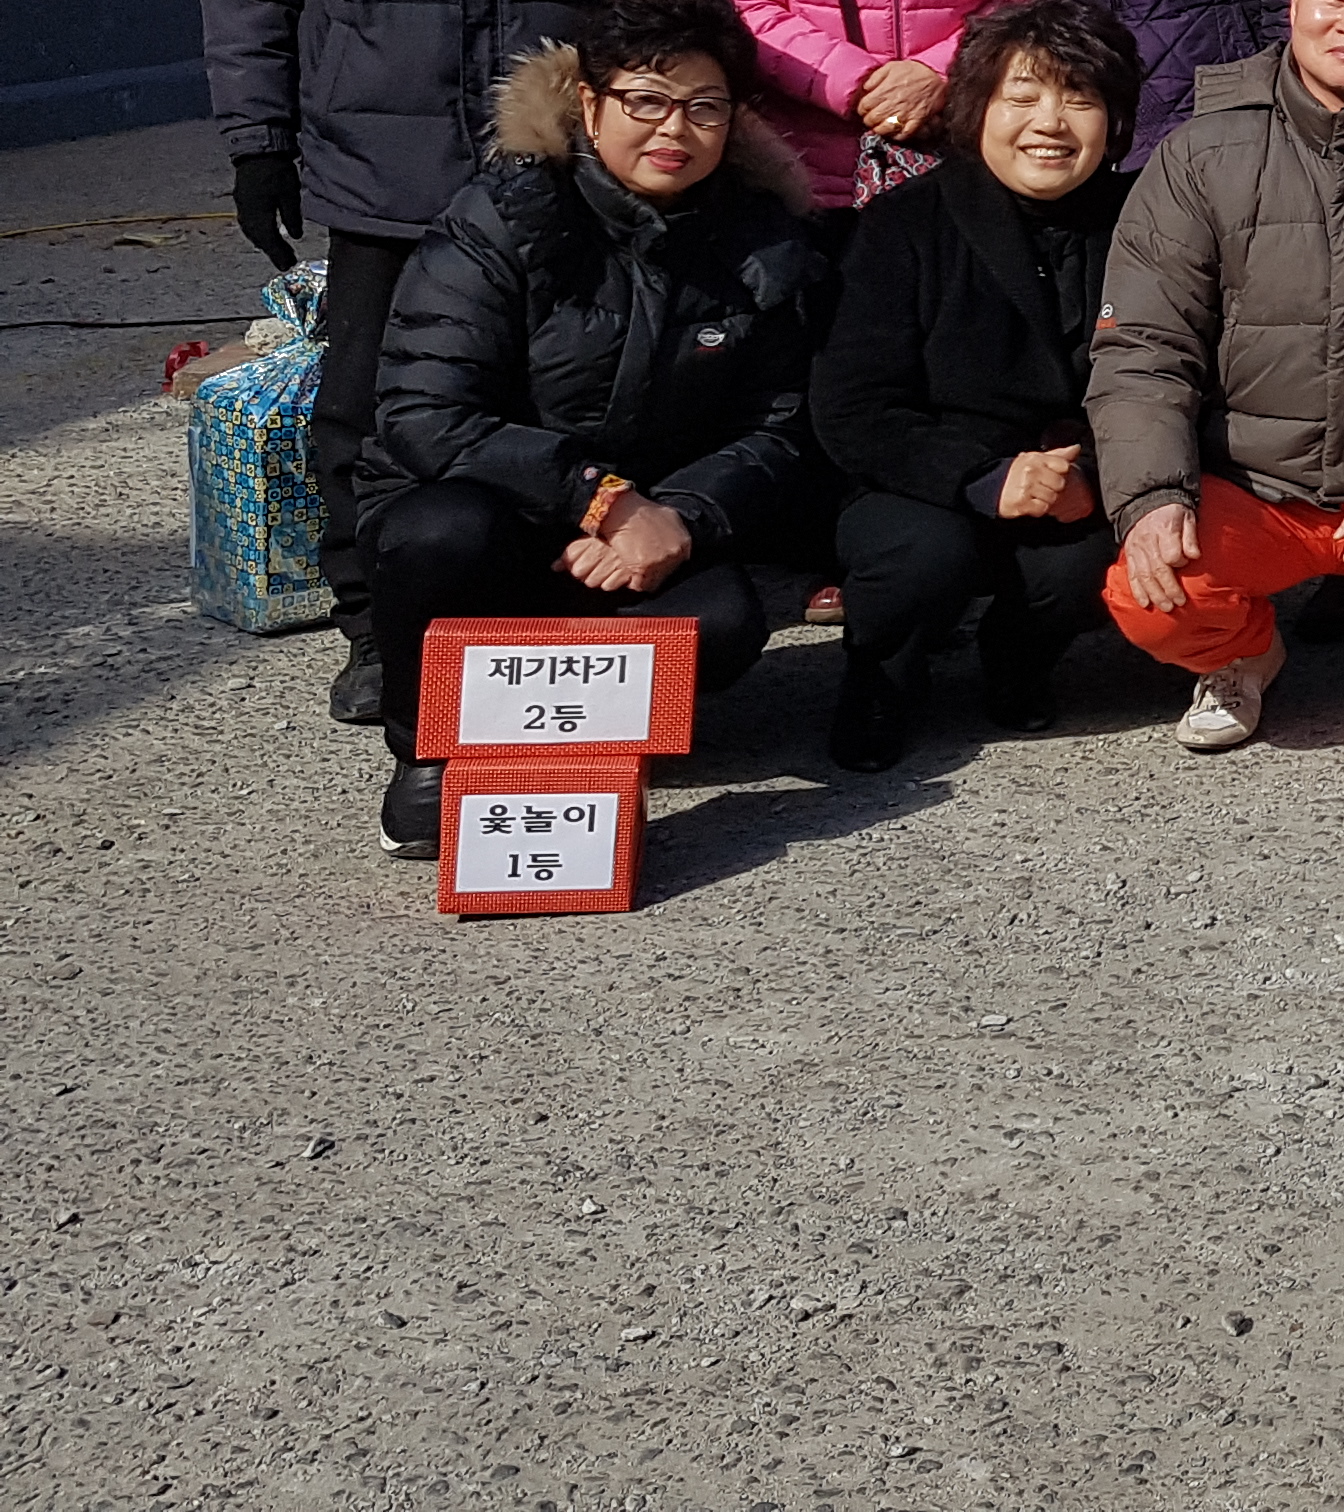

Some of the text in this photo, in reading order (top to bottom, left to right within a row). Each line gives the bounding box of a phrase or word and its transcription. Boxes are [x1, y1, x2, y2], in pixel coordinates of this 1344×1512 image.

[488, 655, 627, 686] 제기차기
[523, 704, 587, 733] 2등
[479, 804, 597, 835] 윷놀이
[507, 853, 563, 881] 1등
